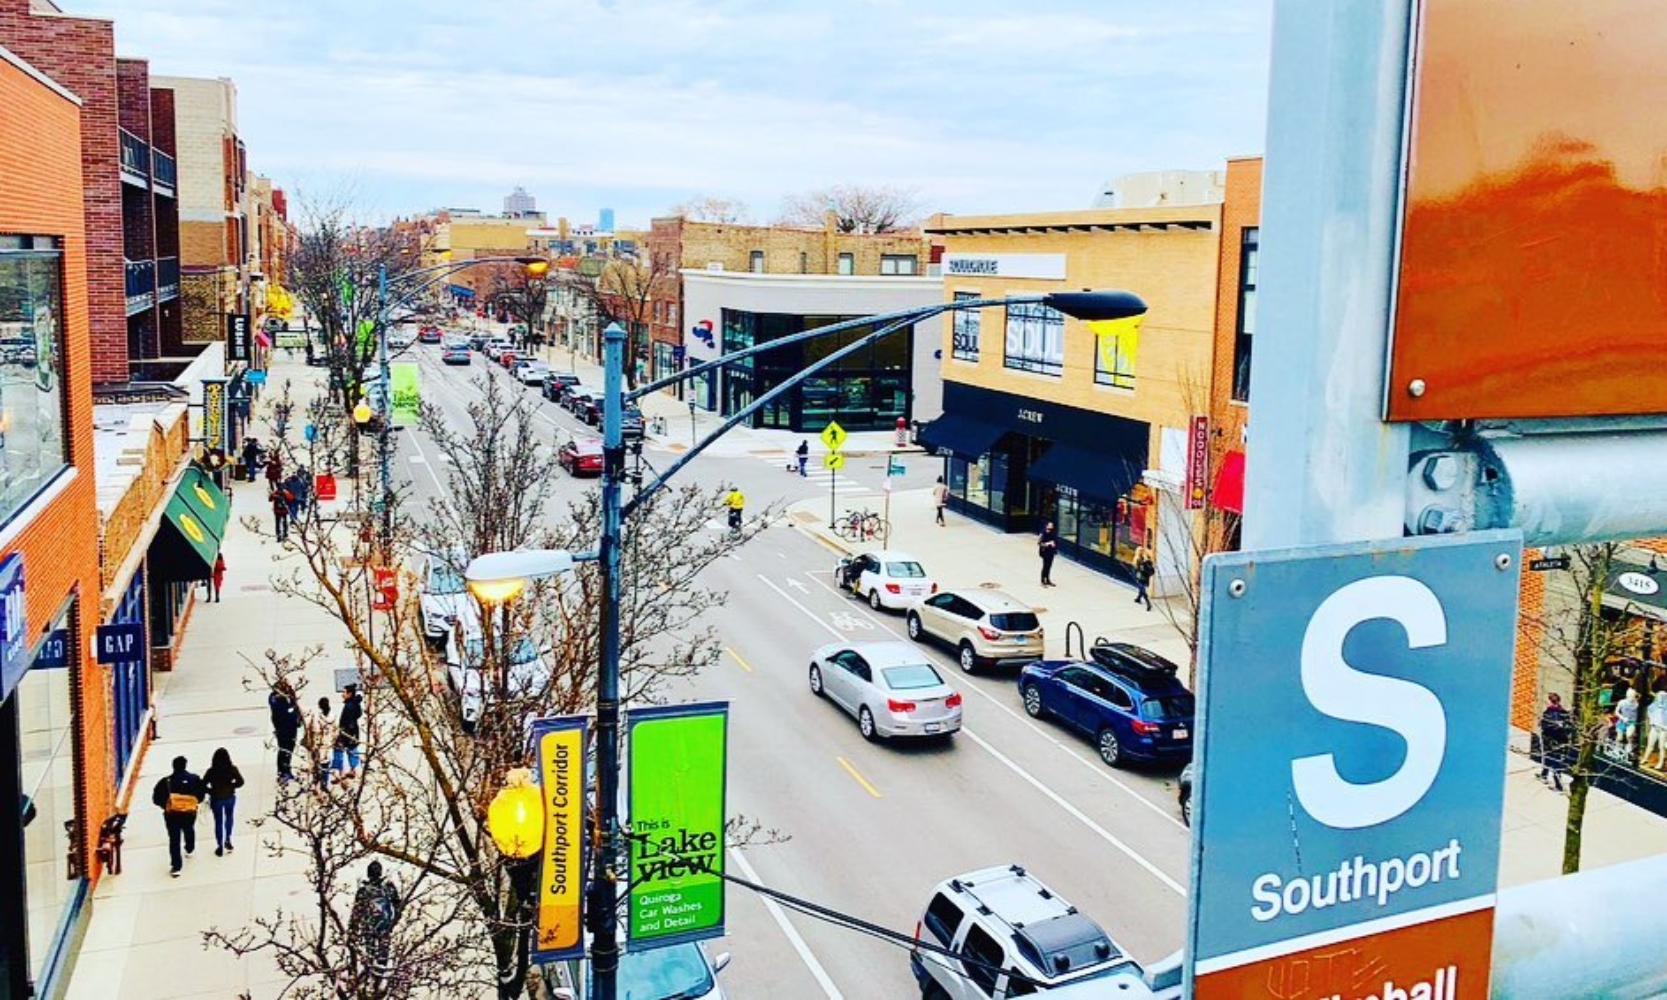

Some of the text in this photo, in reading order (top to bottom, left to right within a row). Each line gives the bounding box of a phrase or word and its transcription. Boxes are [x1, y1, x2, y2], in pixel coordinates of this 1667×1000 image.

[105, 634, 134, 653] GAP
[1291, 576, 1447, 829] S
[551, 743, 571, 895] Southport Corridor
[637, 818, 671, 831] This is
[637, 829, 717, 859] Lake
[637, 853, 717, 882] view
[1251, 840, 1461, 922] Southport
[640, 892, 682, 906] Quiroga
[640, 902, 703, 920] Car Washes
[640, 914, 696, 932] and Detail
